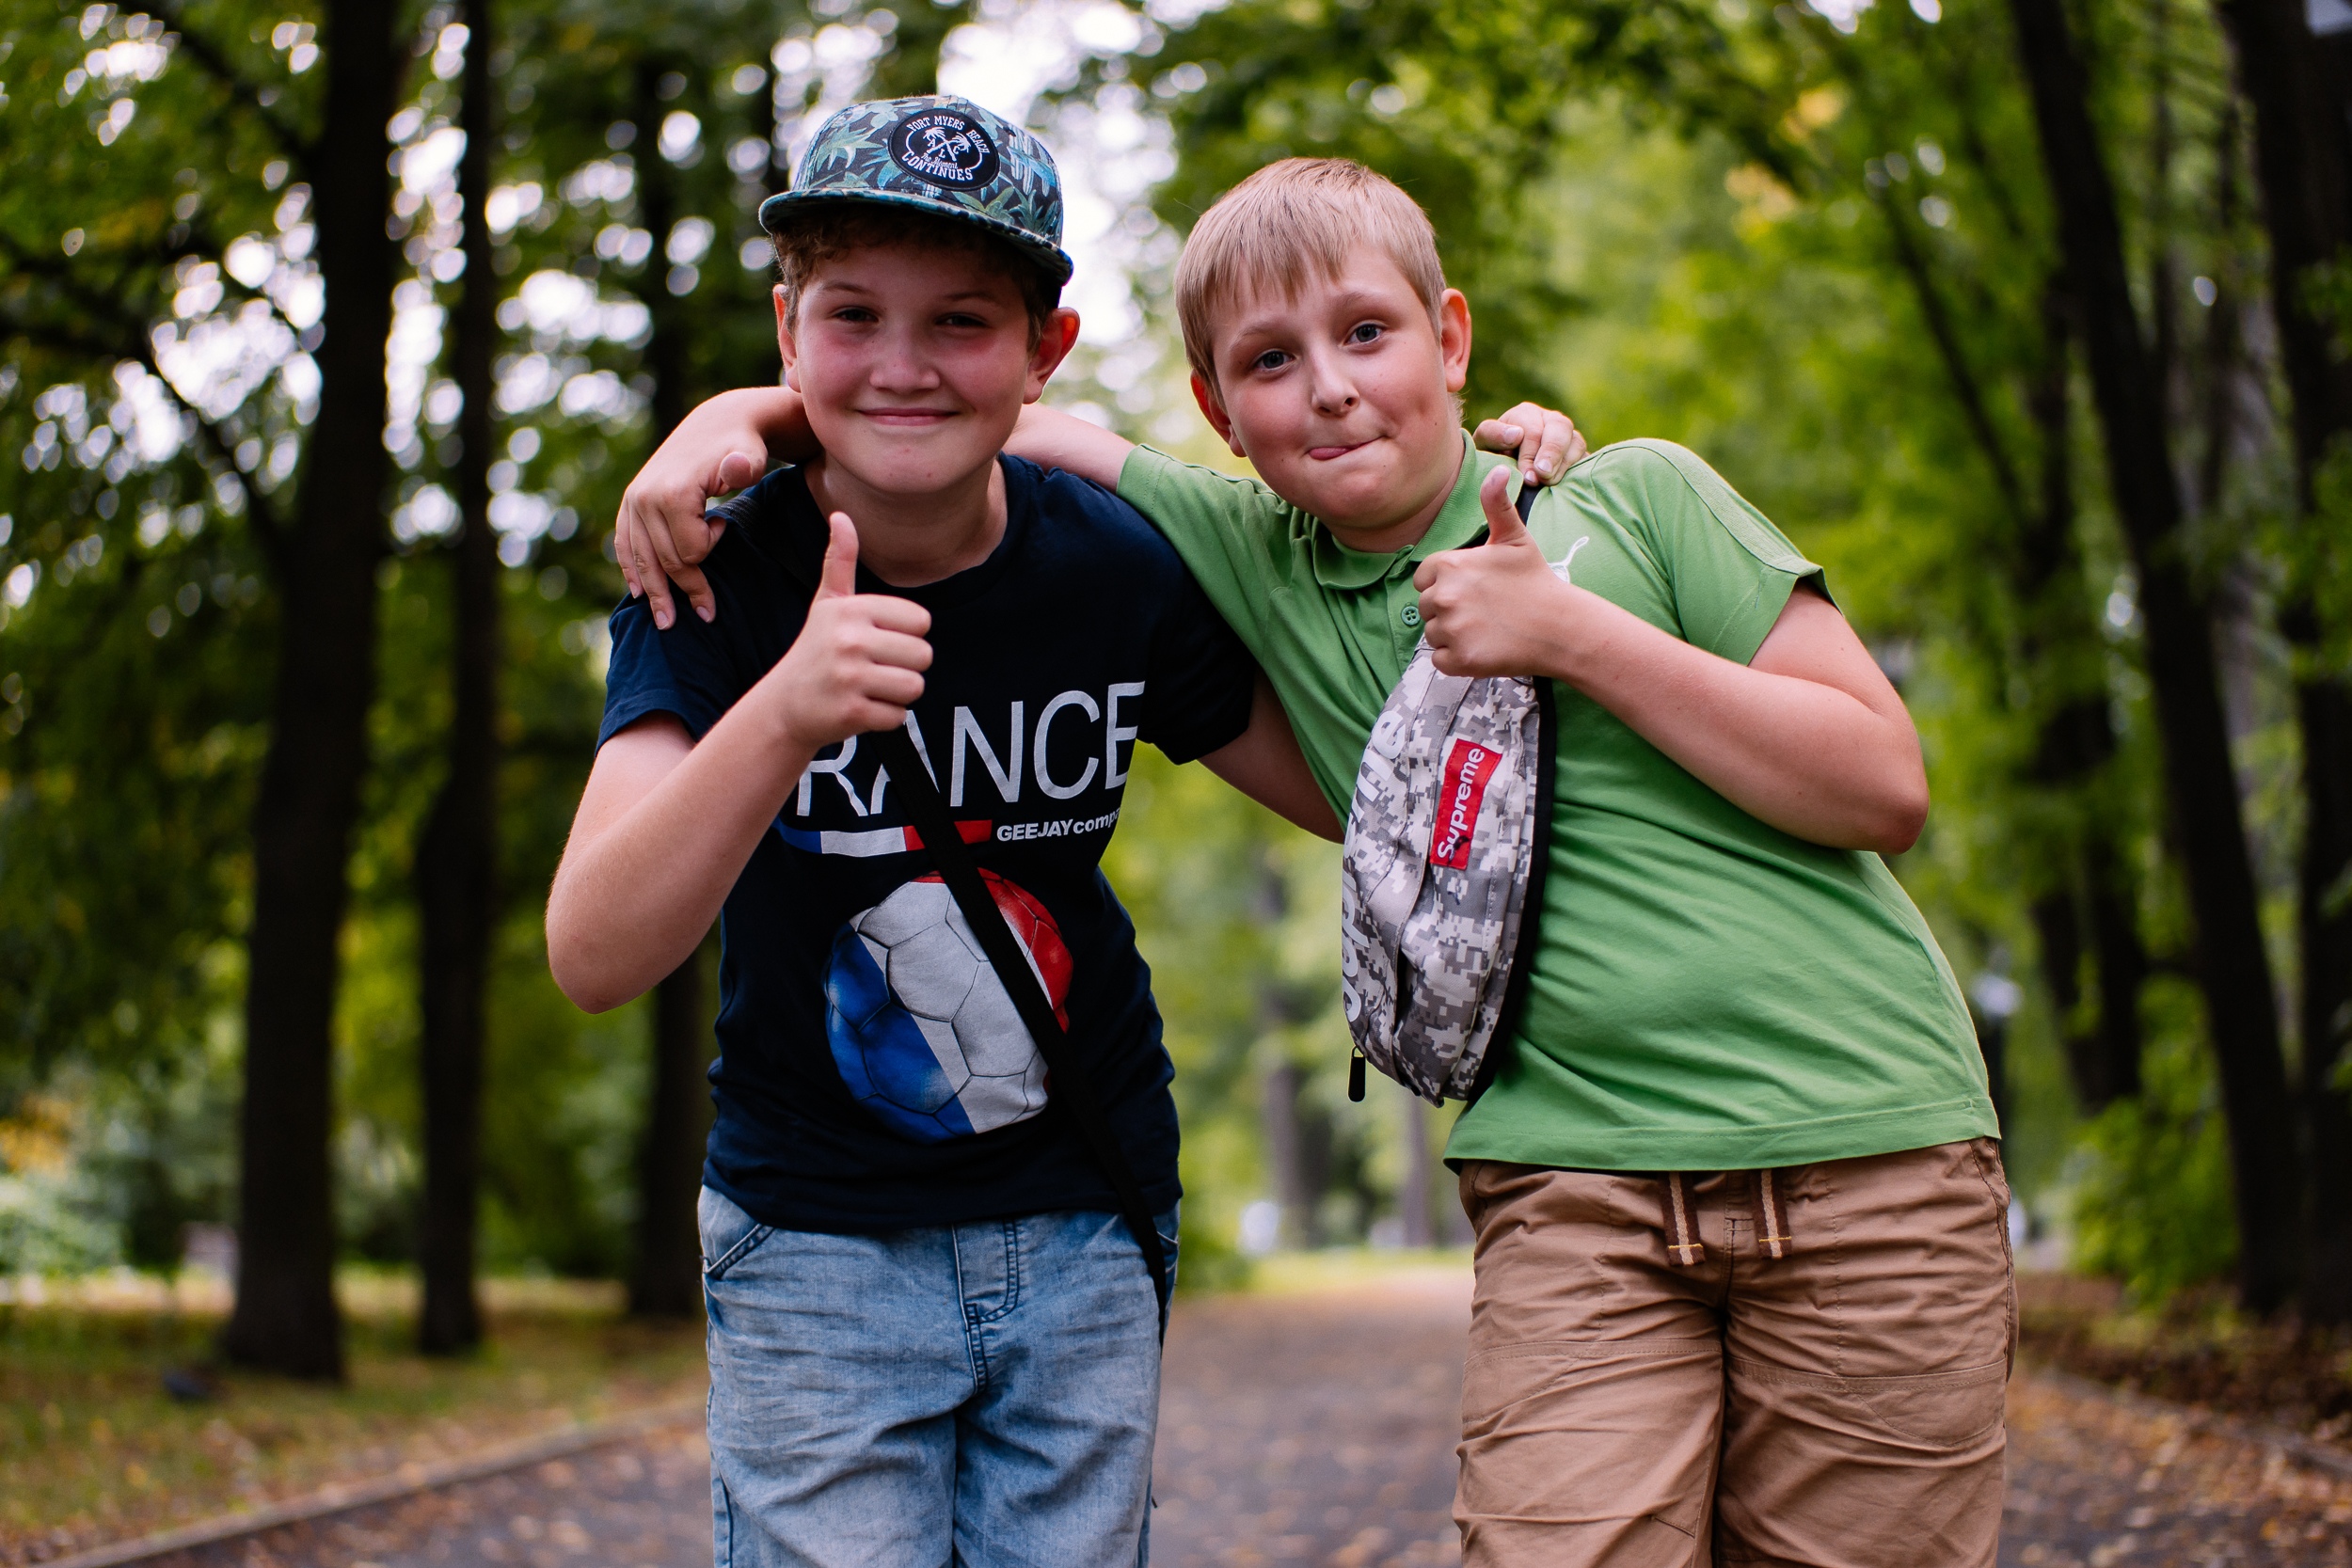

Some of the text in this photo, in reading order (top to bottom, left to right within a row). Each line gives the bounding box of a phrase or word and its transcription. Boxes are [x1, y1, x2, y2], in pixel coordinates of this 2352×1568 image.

[906, 115, 991, 153] FORT MYERS BEACH
[901, 151, 974, 181] CONTINUES
[1437, 748, 1486, 863] Supreme
